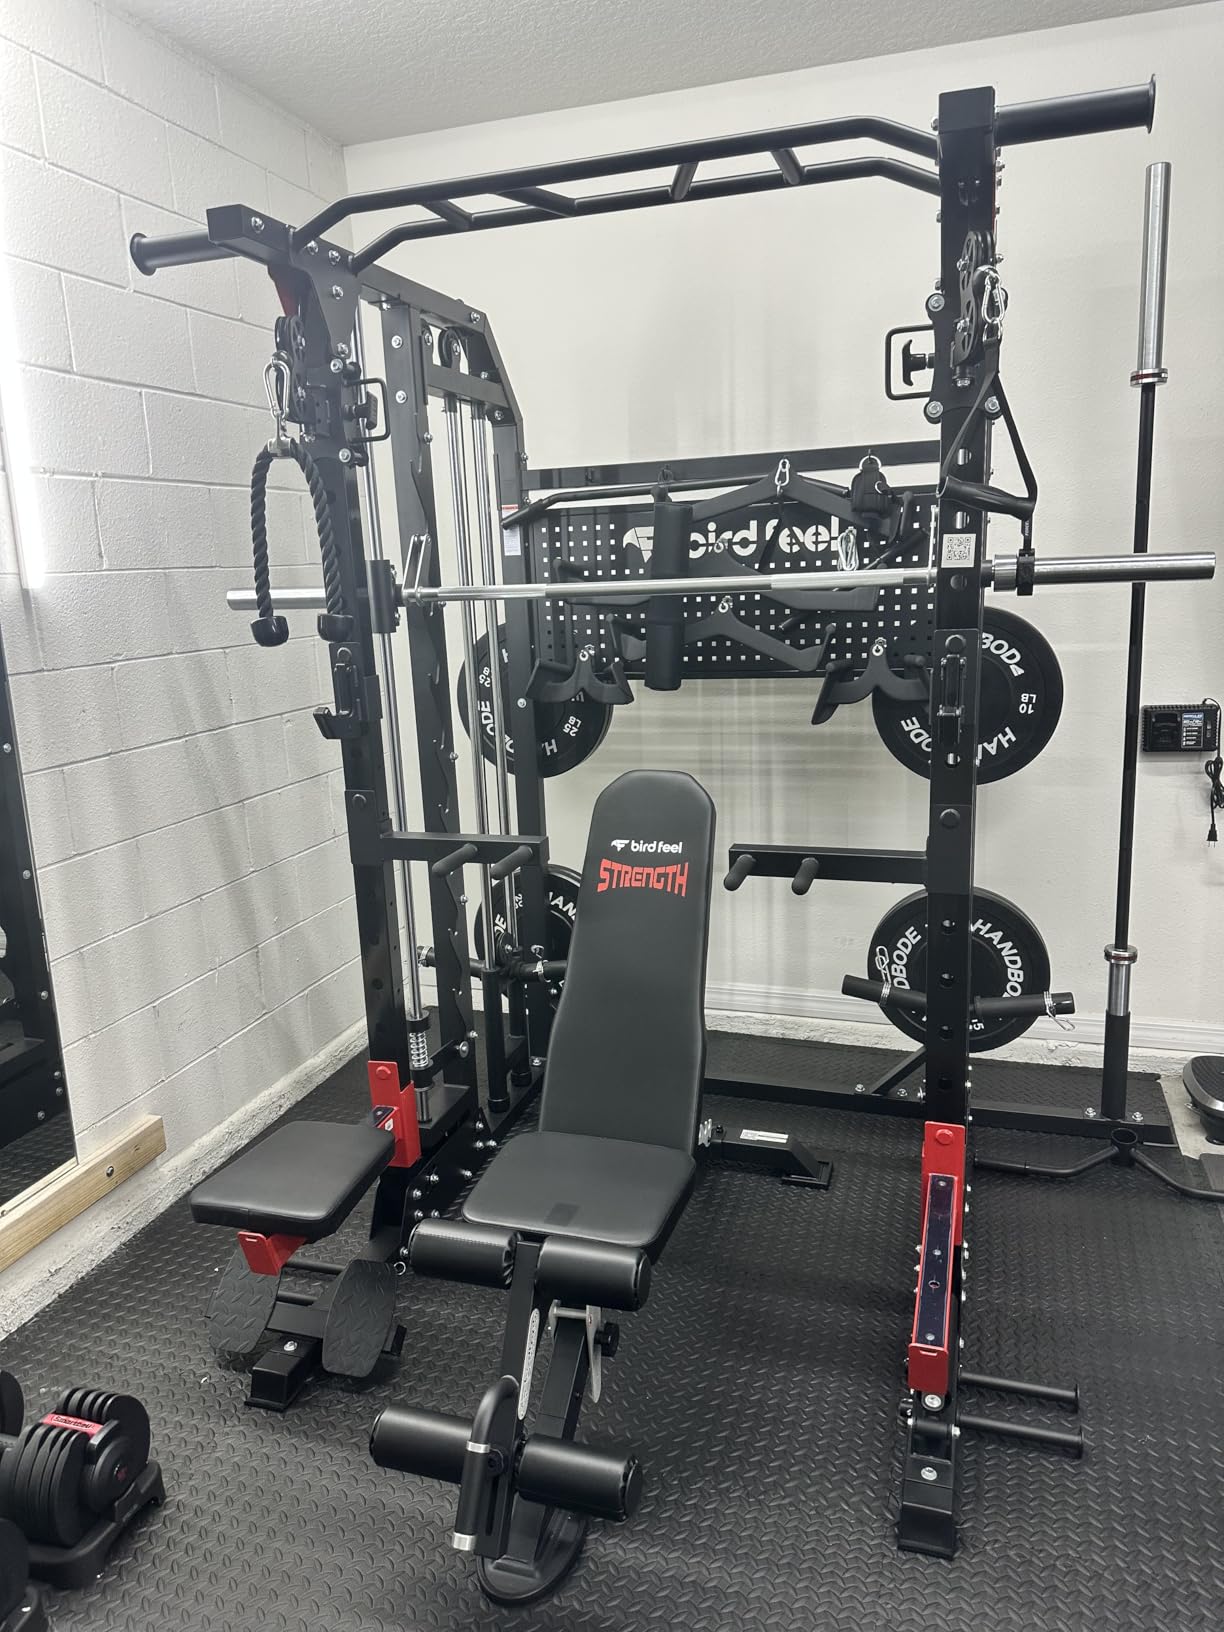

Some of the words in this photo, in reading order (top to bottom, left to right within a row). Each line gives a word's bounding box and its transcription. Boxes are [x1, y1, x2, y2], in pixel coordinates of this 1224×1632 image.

[1021, 693, 1037, 703] LB
[1019, 703, 1035, 715] 10
[563, 723, 579, 737] 25
[630, 839, 657, 853] bird
[657, 841, 683, 854] feel
[597, 858, 689, 897] STRENGTH
